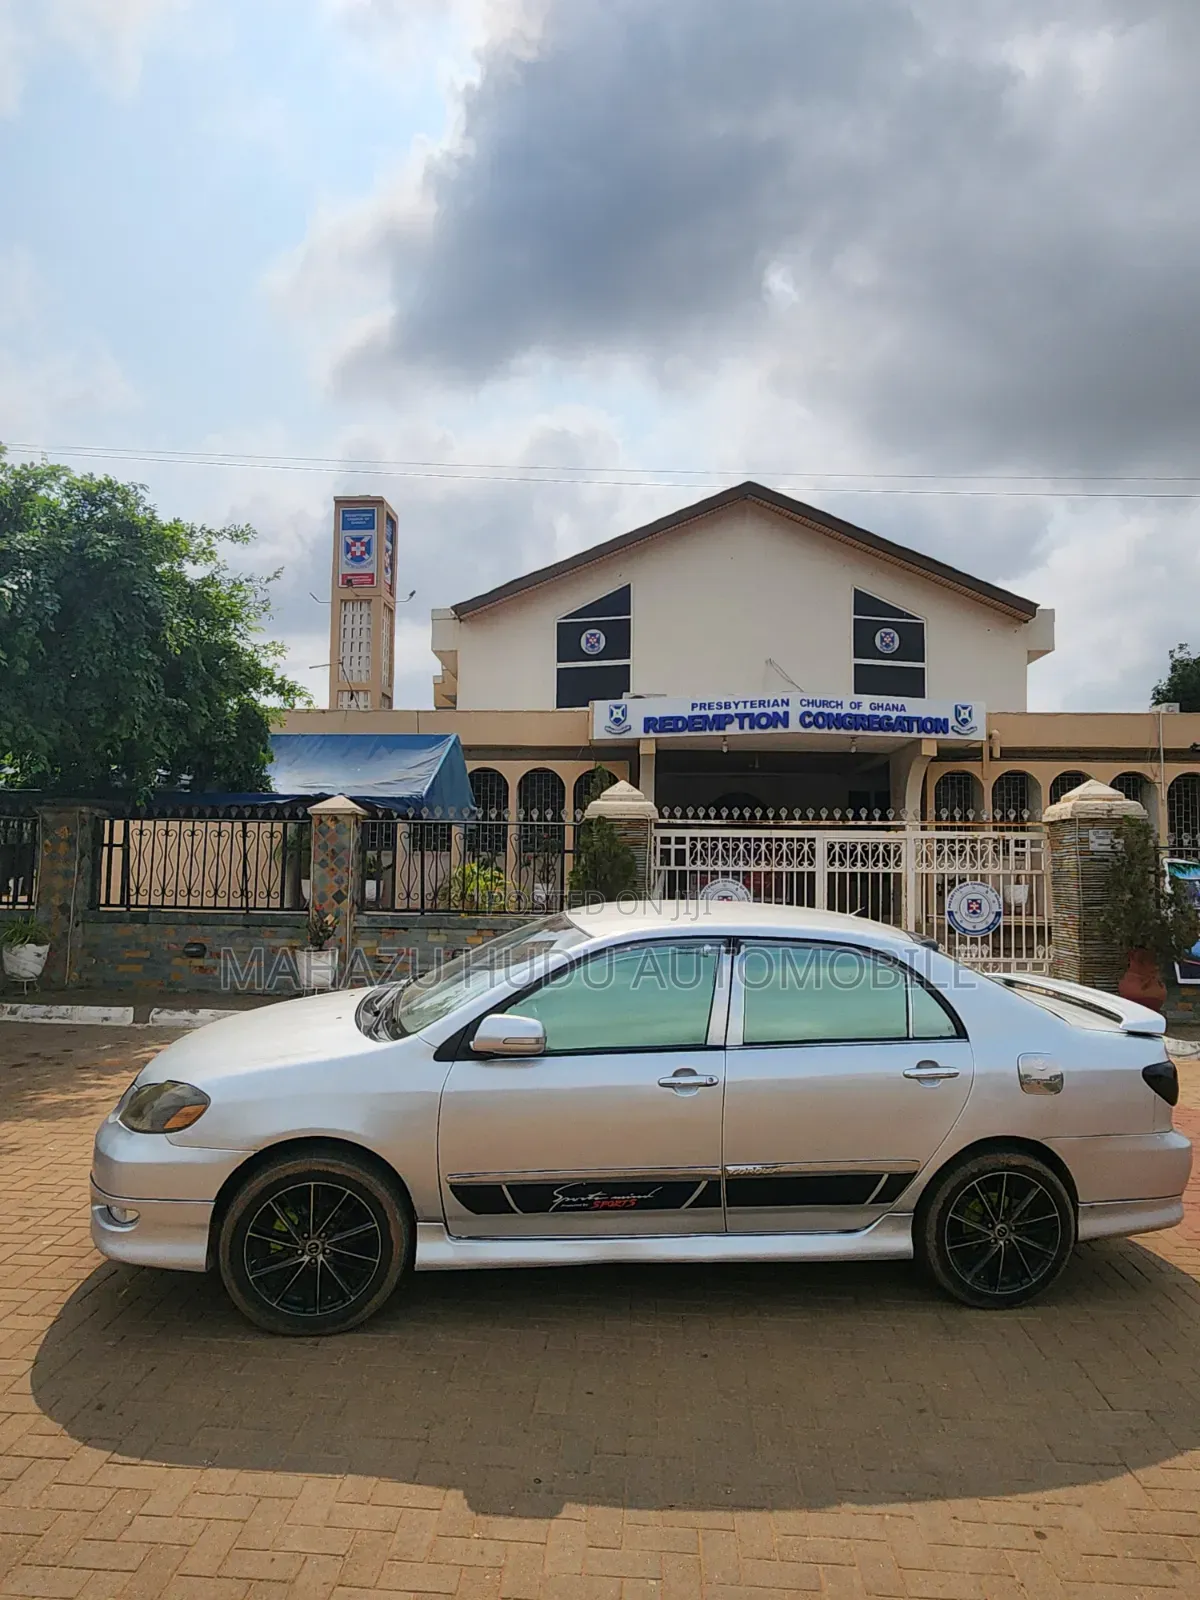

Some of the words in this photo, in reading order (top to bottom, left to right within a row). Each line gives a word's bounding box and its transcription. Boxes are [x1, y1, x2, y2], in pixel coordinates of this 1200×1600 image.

[691, 698, 790, 711] PRESBYTERIAN
[800, 699, 843, 709] CHURCH
[850, 701, 863, 711] OF
[869, 702, 907, 712] GHANA
[643, 711, 789, 734] REDEMPTION
[799, 711, 949, 734] CONGREGATION
[592, 1199, 637, 1208] SPORTS
